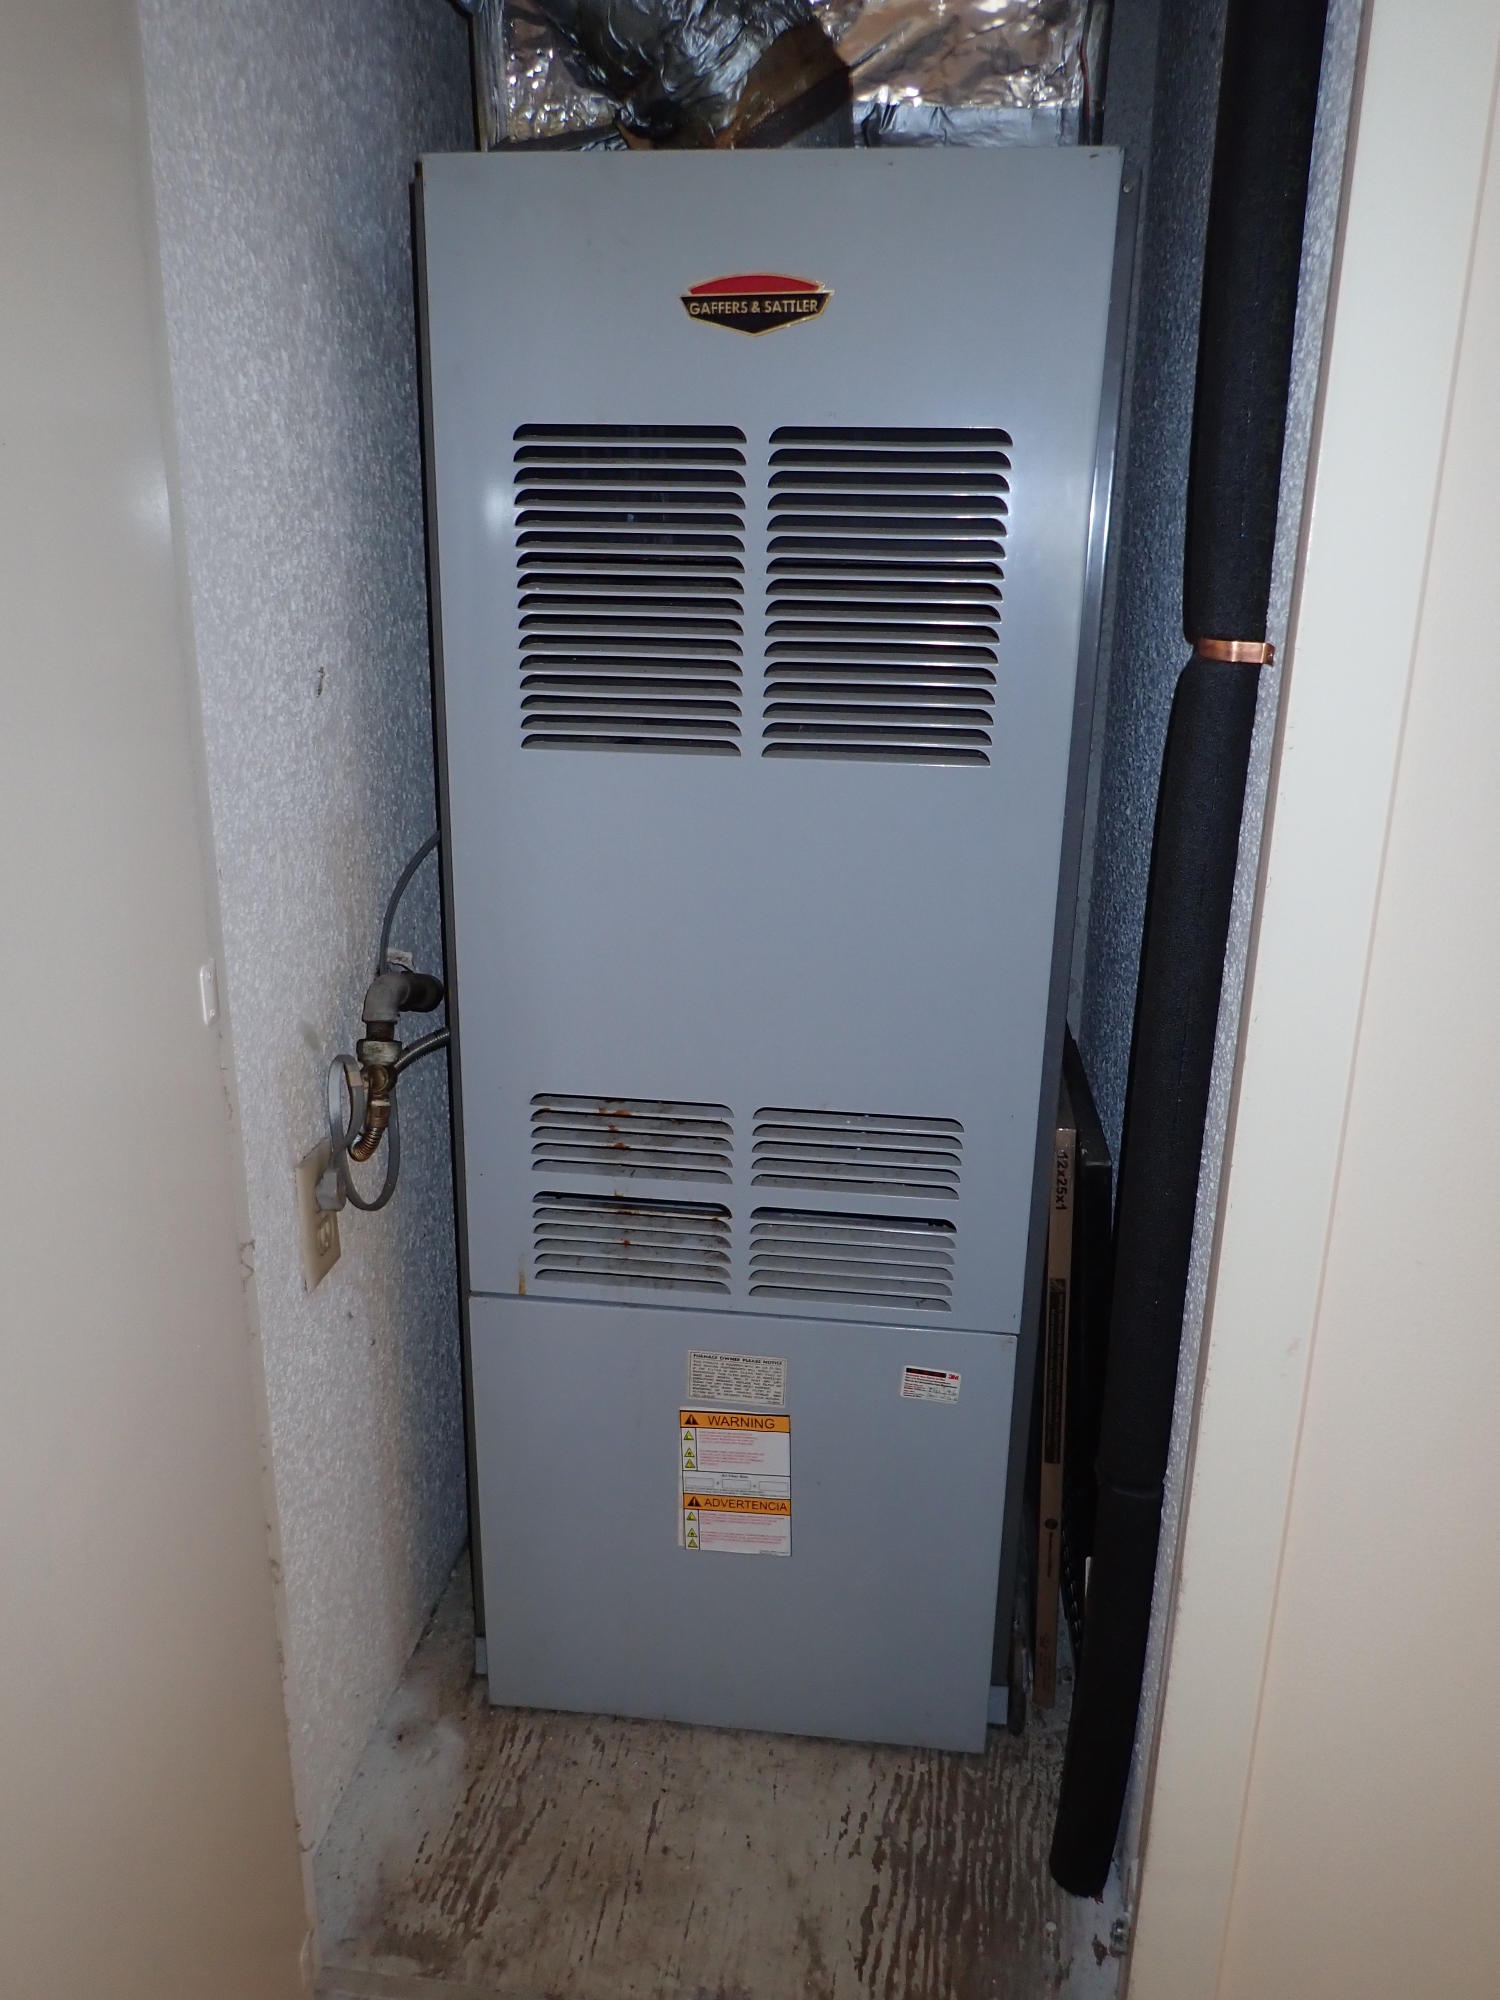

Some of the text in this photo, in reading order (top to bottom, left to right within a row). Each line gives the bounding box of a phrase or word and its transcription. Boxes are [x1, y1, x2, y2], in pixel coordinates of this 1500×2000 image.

[689, 299, 818, 315] GAFFERS & SATTLER
[1056, 1151, 1069, 1211] 12x25x1
[707, 1415, 775, 1429] WARNING
[704, 1498, 788, 1512] ADVERTENCIA
